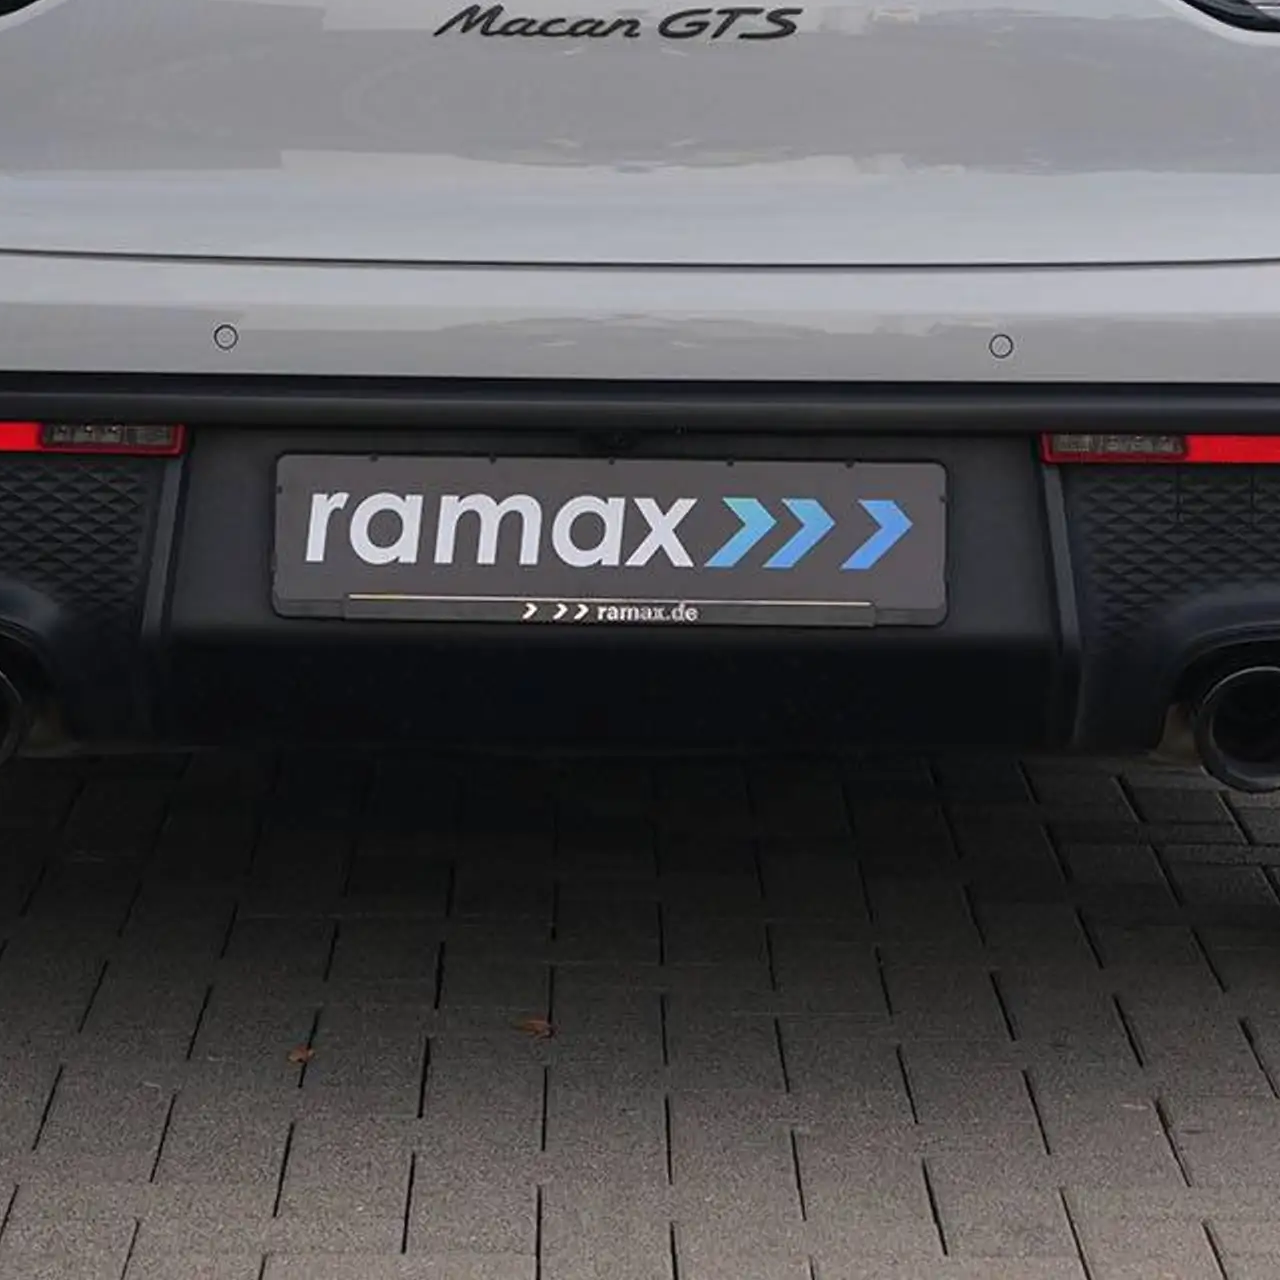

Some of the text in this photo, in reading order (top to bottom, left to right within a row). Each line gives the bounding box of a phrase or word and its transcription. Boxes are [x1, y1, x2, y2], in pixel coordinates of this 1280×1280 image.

[433, 3, 804, 40] Macan GTS
[305, 492, 698, 569] ramax
[596, 602, 699, 621] ramax.de
